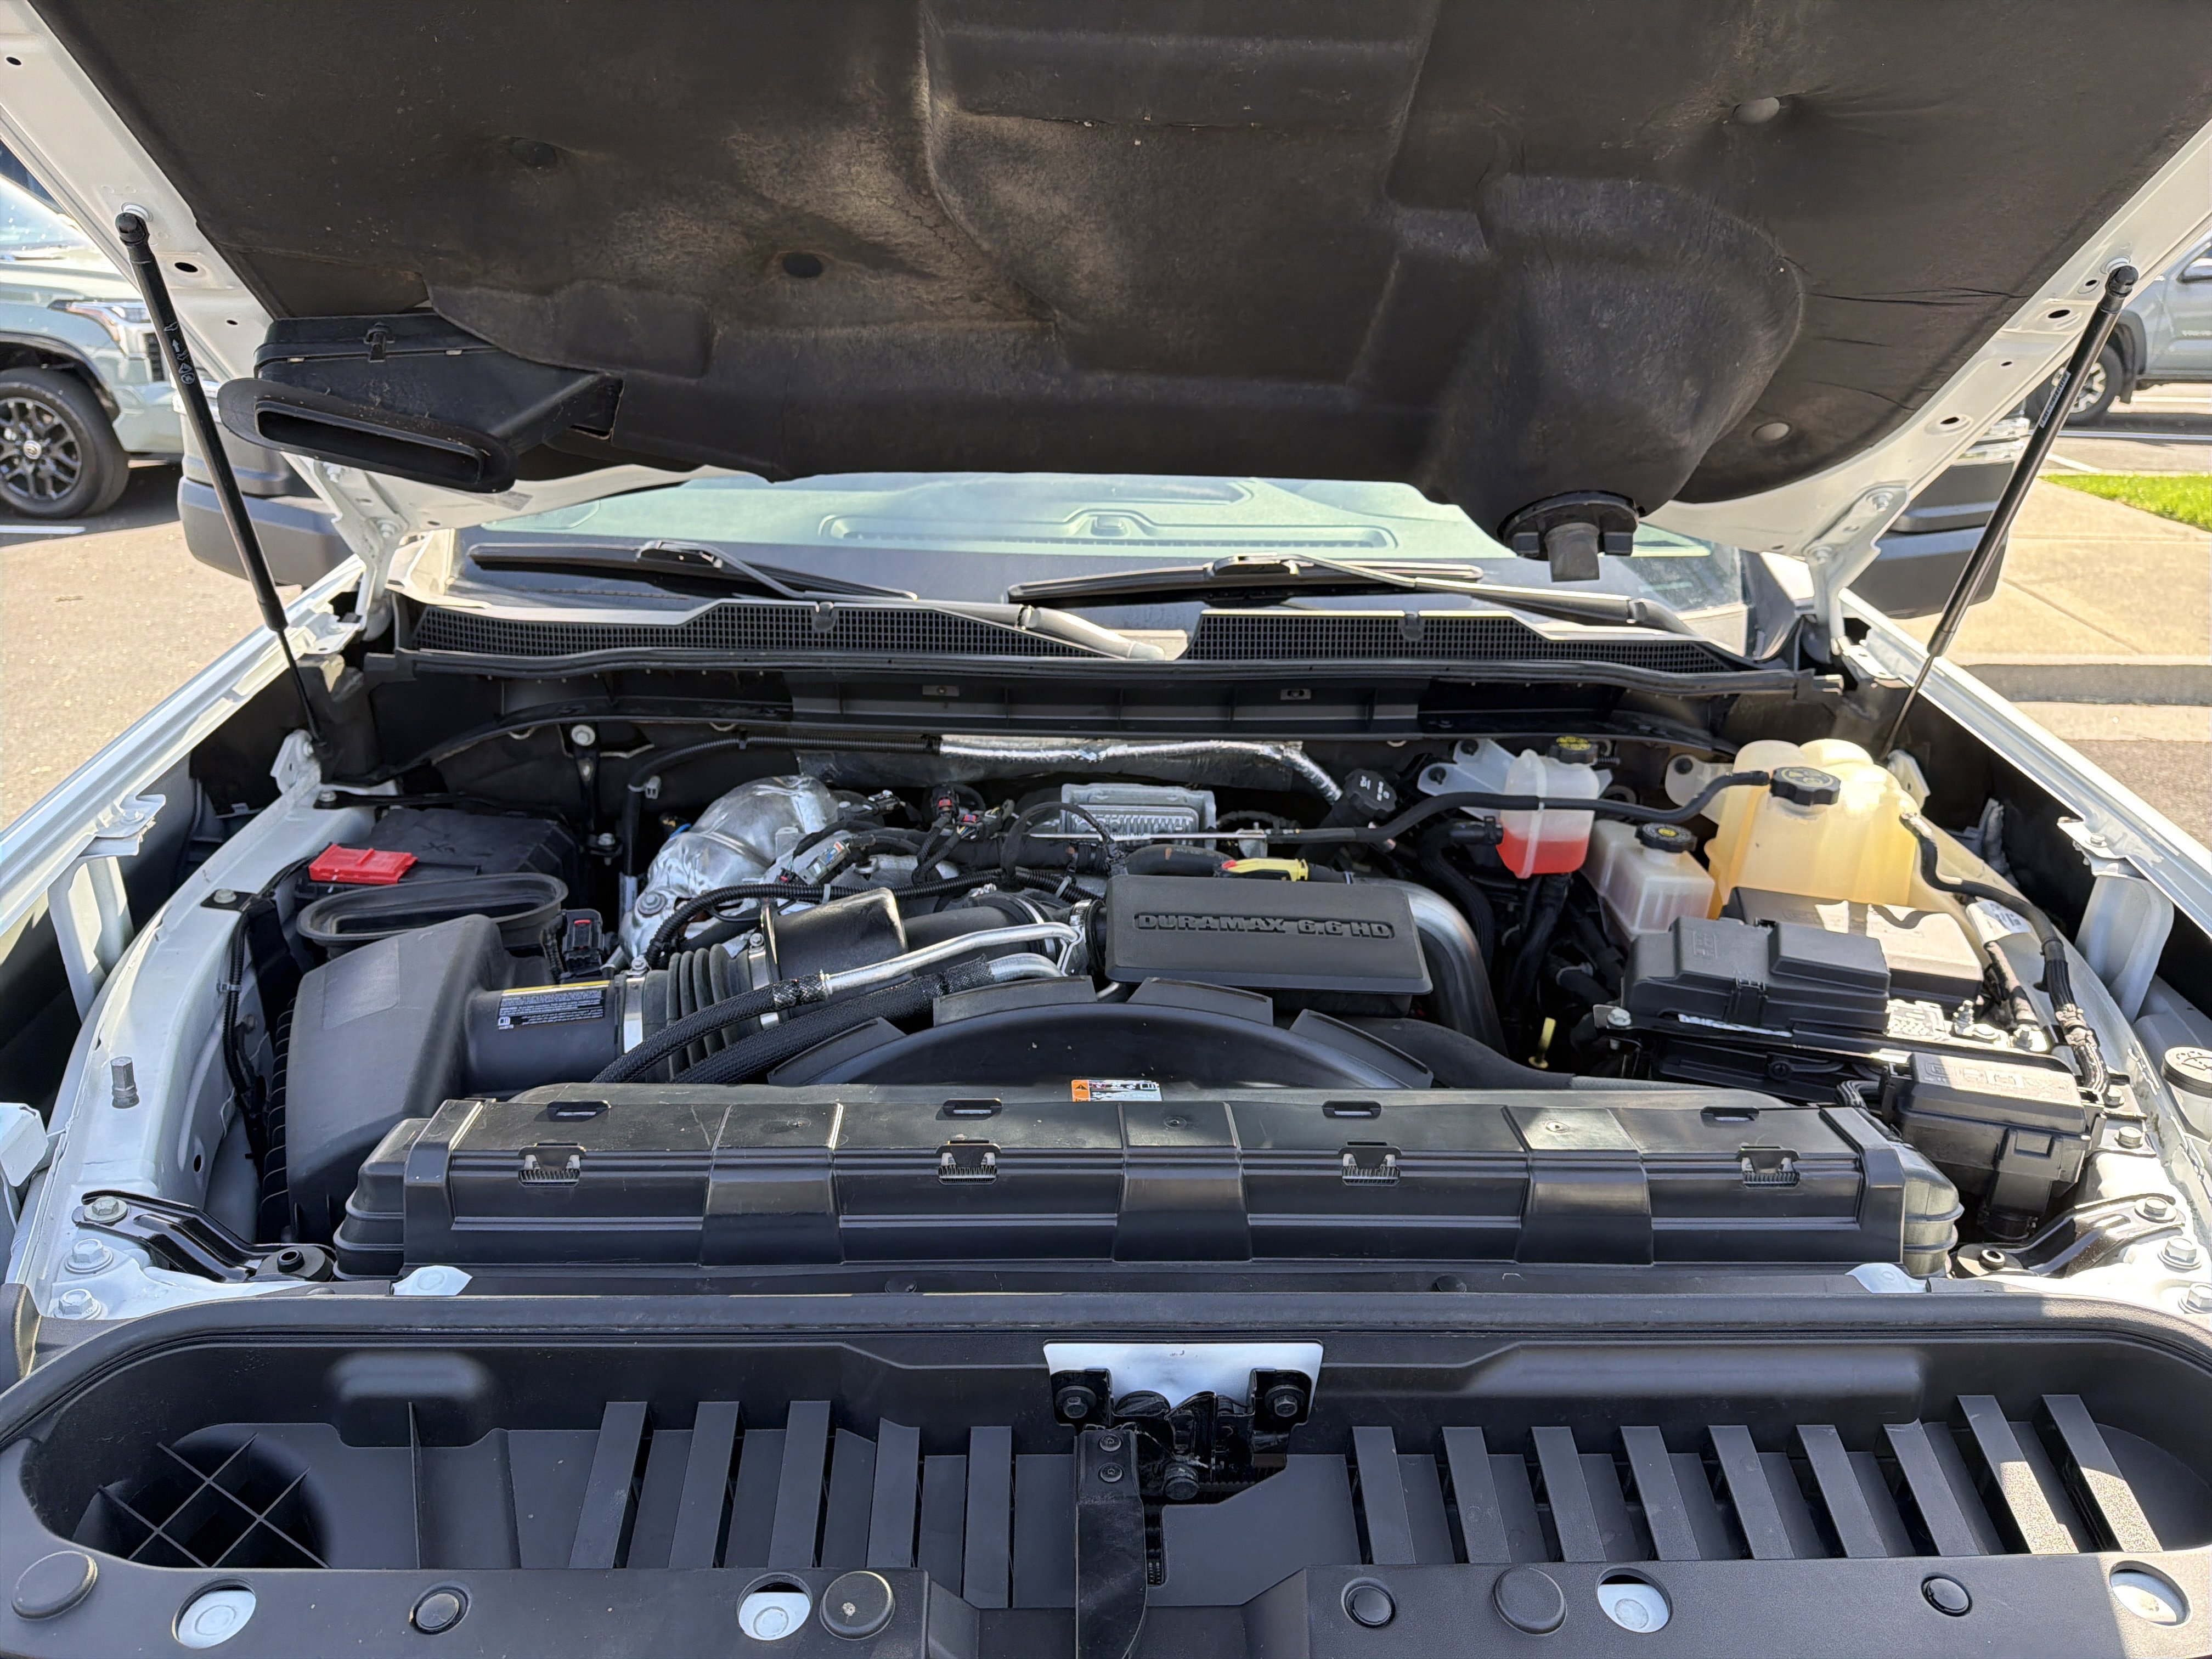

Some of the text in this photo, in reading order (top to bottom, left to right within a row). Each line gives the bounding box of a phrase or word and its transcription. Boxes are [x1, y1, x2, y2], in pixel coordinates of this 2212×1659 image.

[1138, 915, 1390, 938] DURAMAX 6.6 HD
